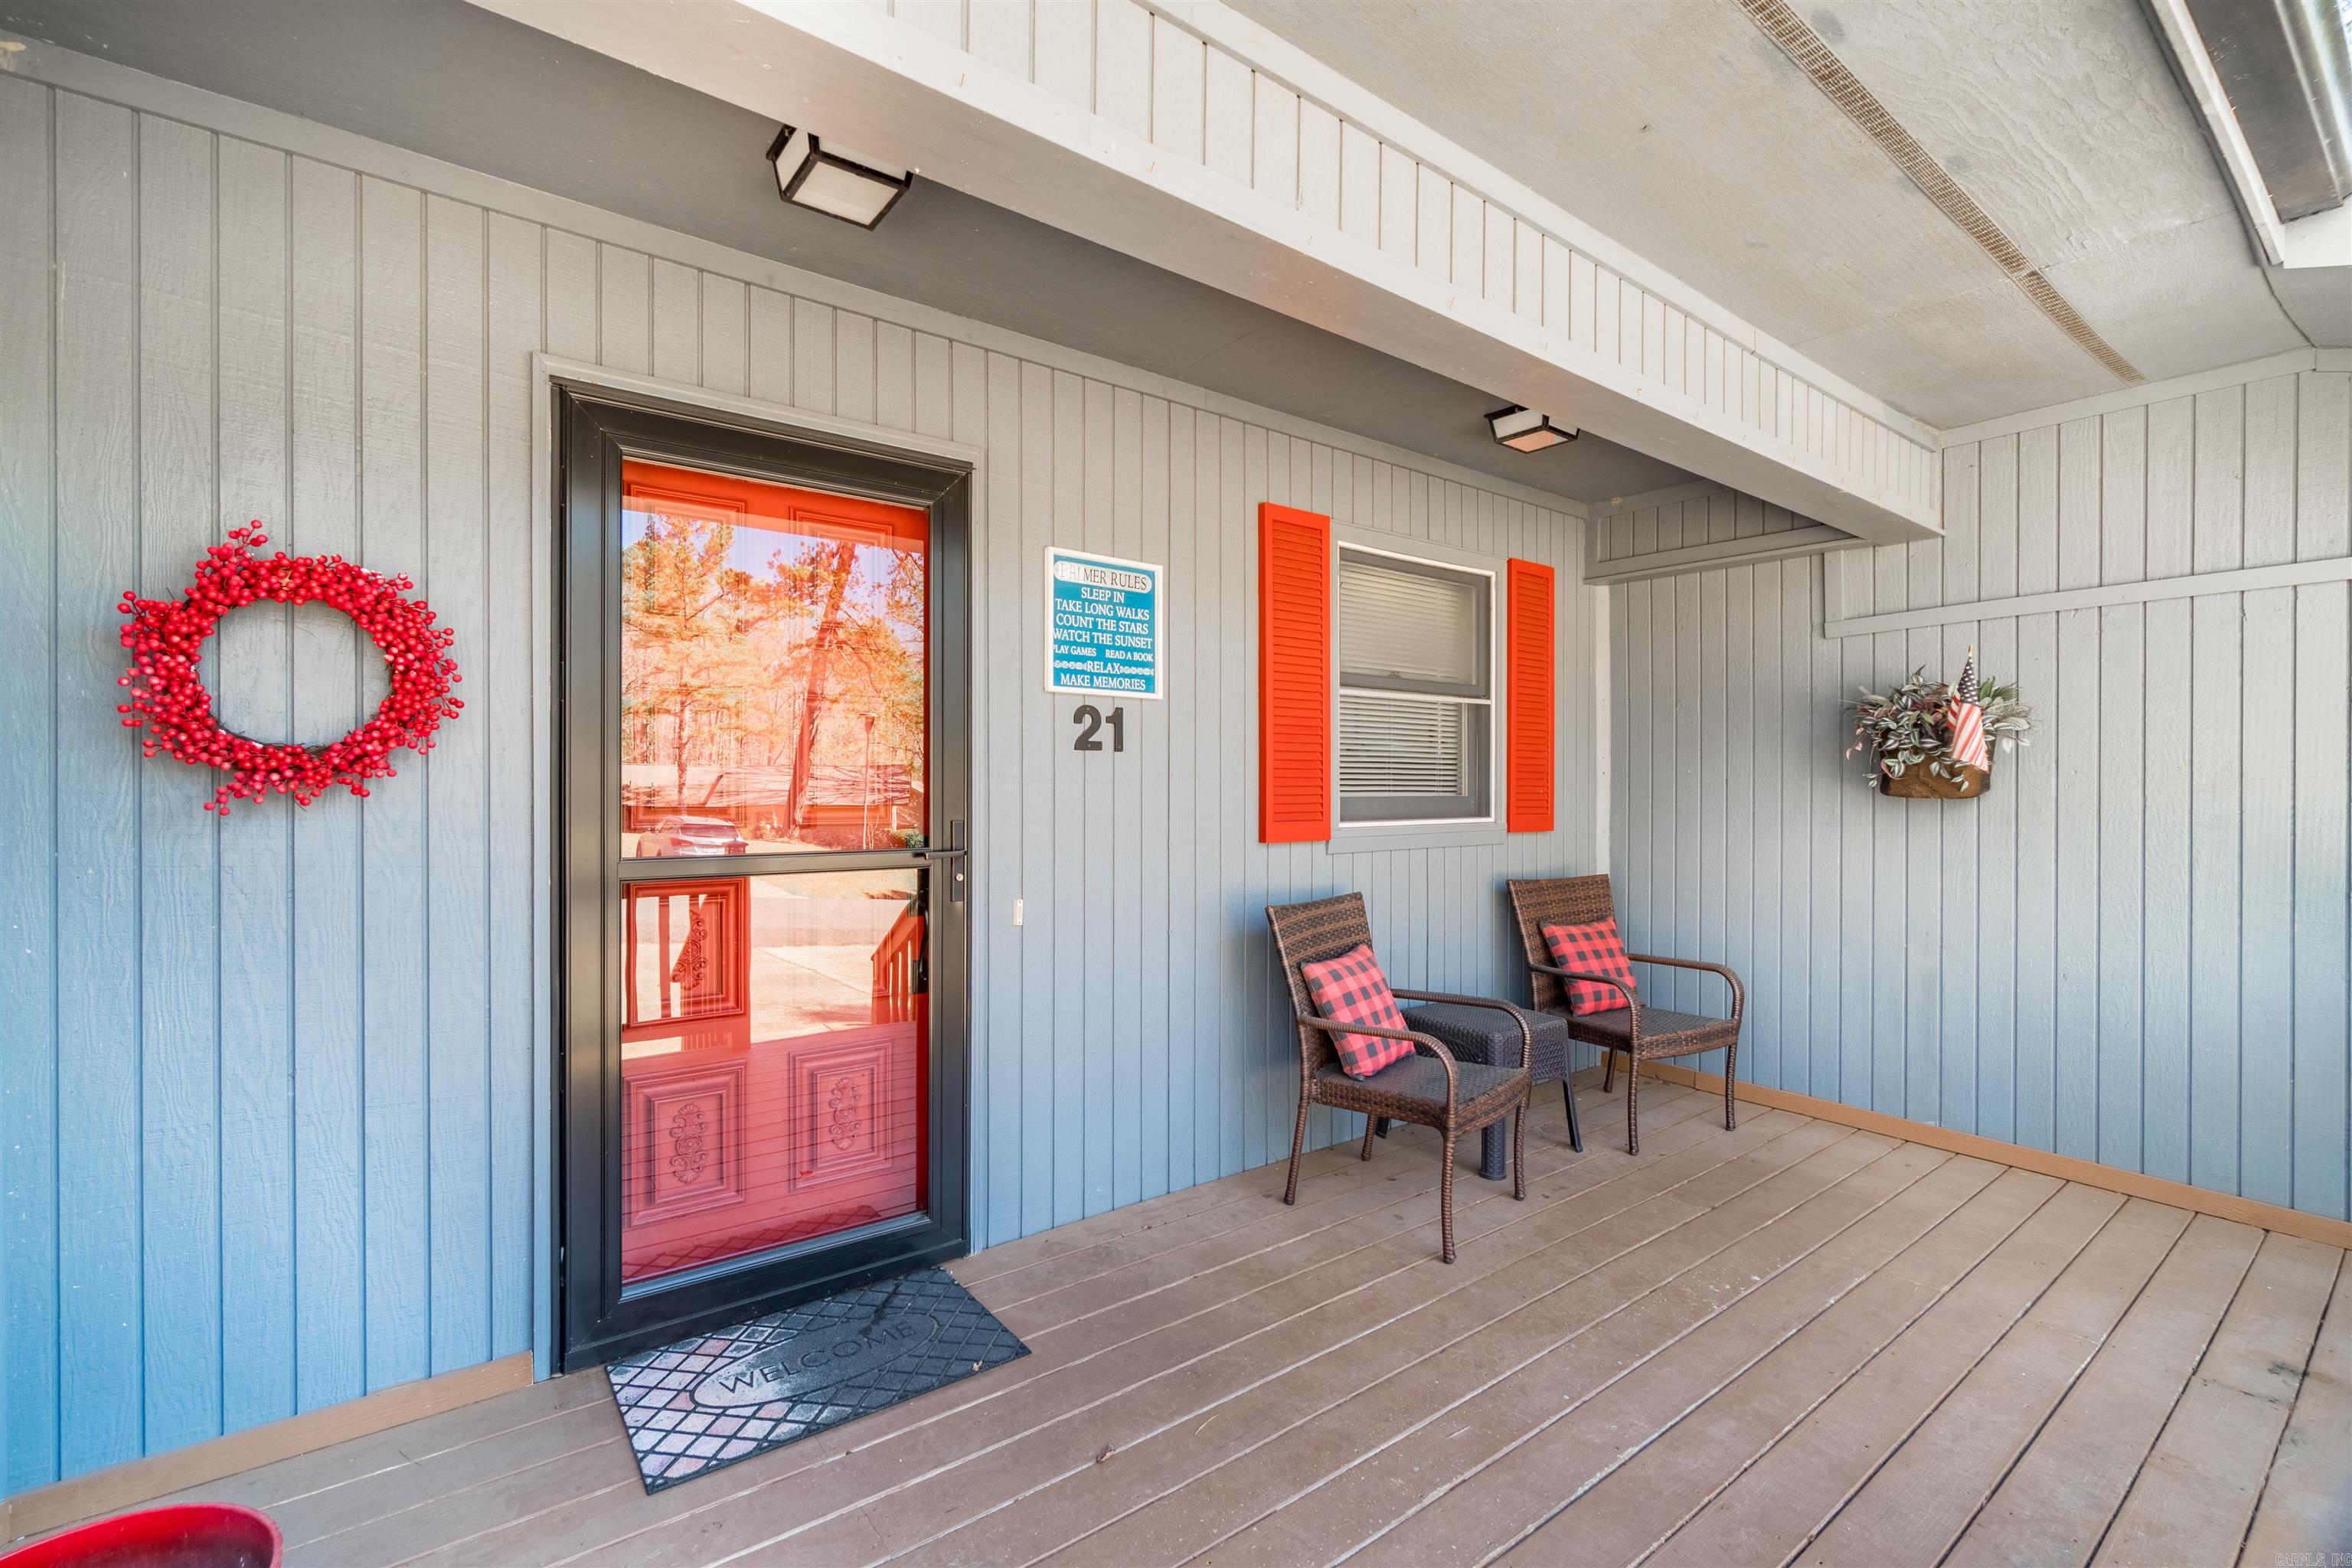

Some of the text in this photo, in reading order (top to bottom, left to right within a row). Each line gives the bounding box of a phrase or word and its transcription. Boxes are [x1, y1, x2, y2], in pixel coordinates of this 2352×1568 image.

[1111, 572, 1147, 590] RULES
[1081, 586, 1125, 603] SLEEP IN
[1055, 598, 1150, 620] TAKE LONG WALKS
[1056, 613, 1148, 635] COUNT THE STARS
[1053, 628, 1153, 649] WATCH THE SUNSET
[1053, 644, 1154, 662] PLAY GAMES READ A BOOK
[1087, 661, 1120, 674] RELAX
[1060, 673, 1146, 690] MAKE MEMORIES
[1073, 704, 1124, 753] 21
[718, 1320, 917, 1393] WELCOME
